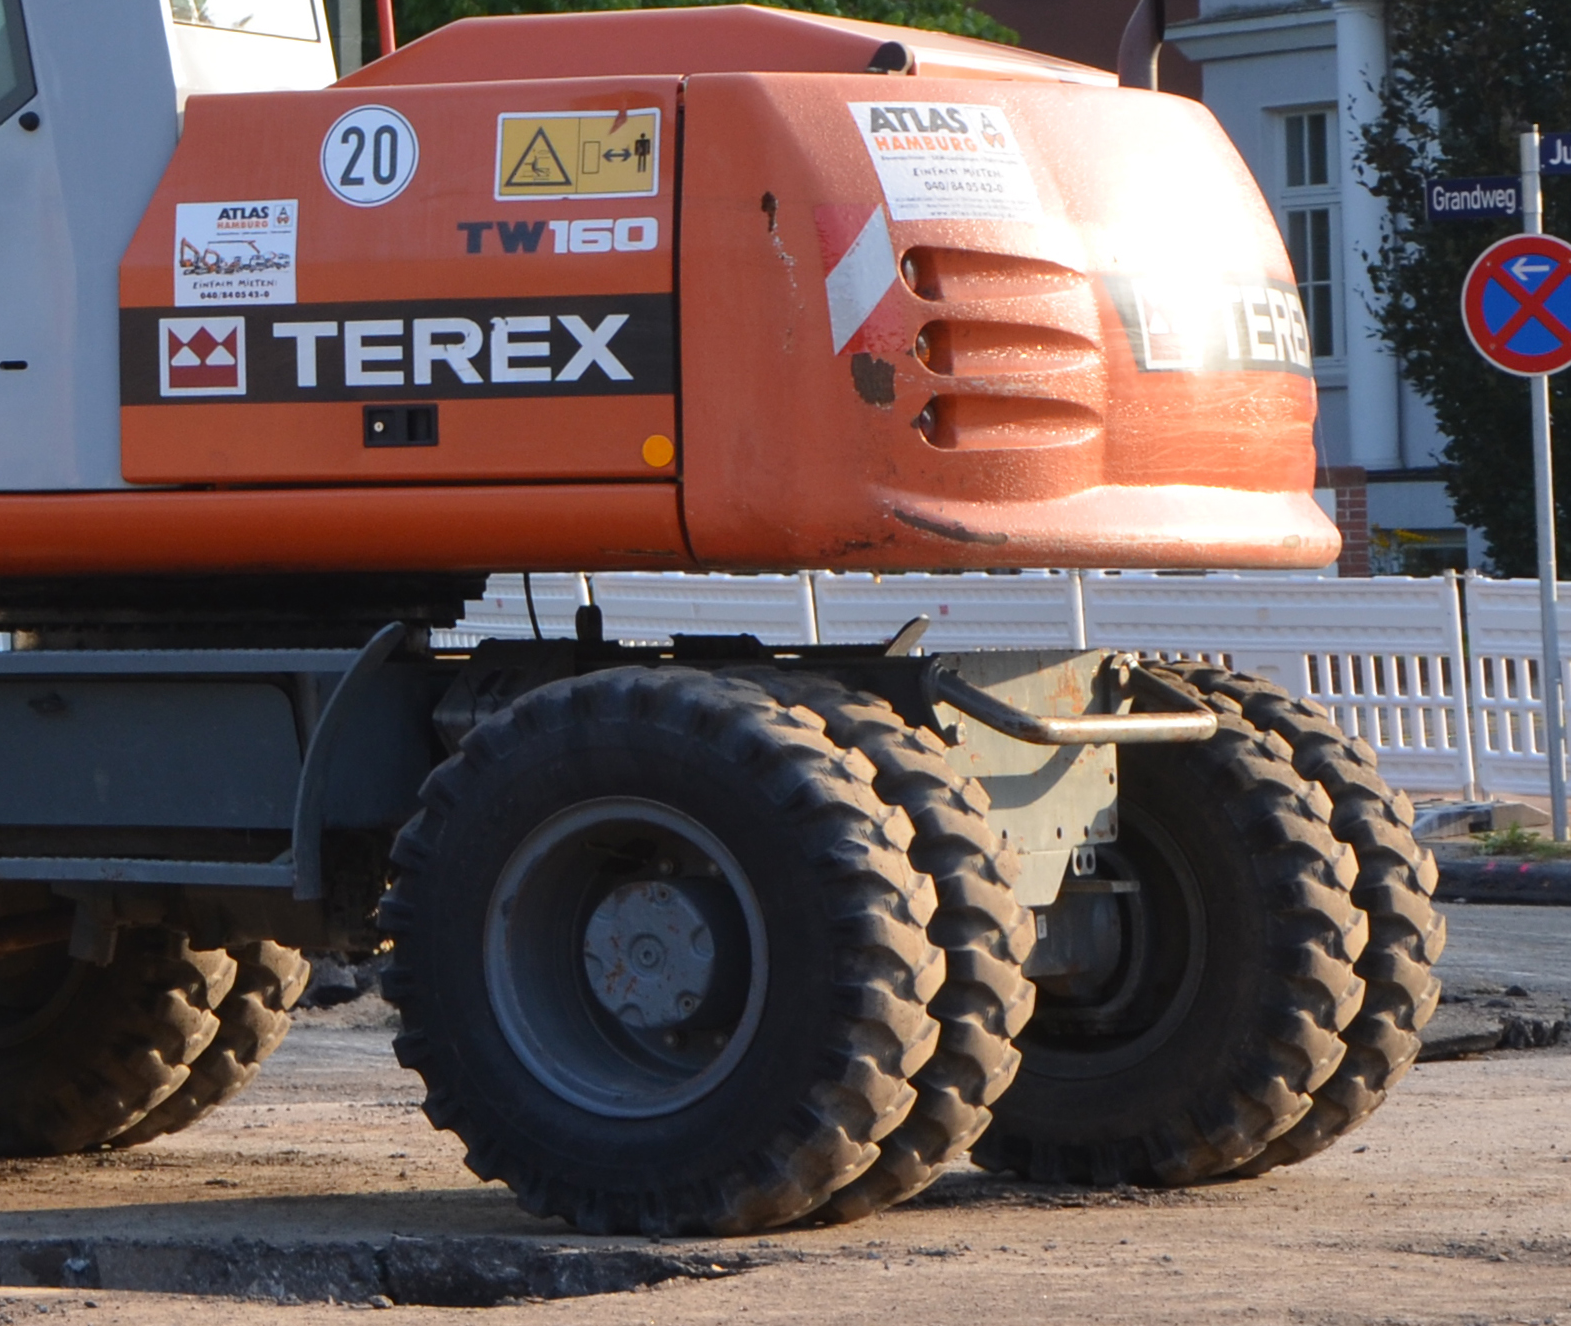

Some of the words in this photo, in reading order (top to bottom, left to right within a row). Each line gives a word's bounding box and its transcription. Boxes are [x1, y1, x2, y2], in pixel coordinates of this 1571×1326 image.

[870, 107, 969, 134] ATLAS
[340, 125, 398, 186] 20
[874, 135, 978, 152] HAMBURG
[1432, 184, 1517, 214] Grandweg
[216, 220, 269, 229] HAMBURG
[217, 206, 270, 221] ATLAS
[457, 217, 658, 254] TW160
[273, 313, 635, 387] TEREX
